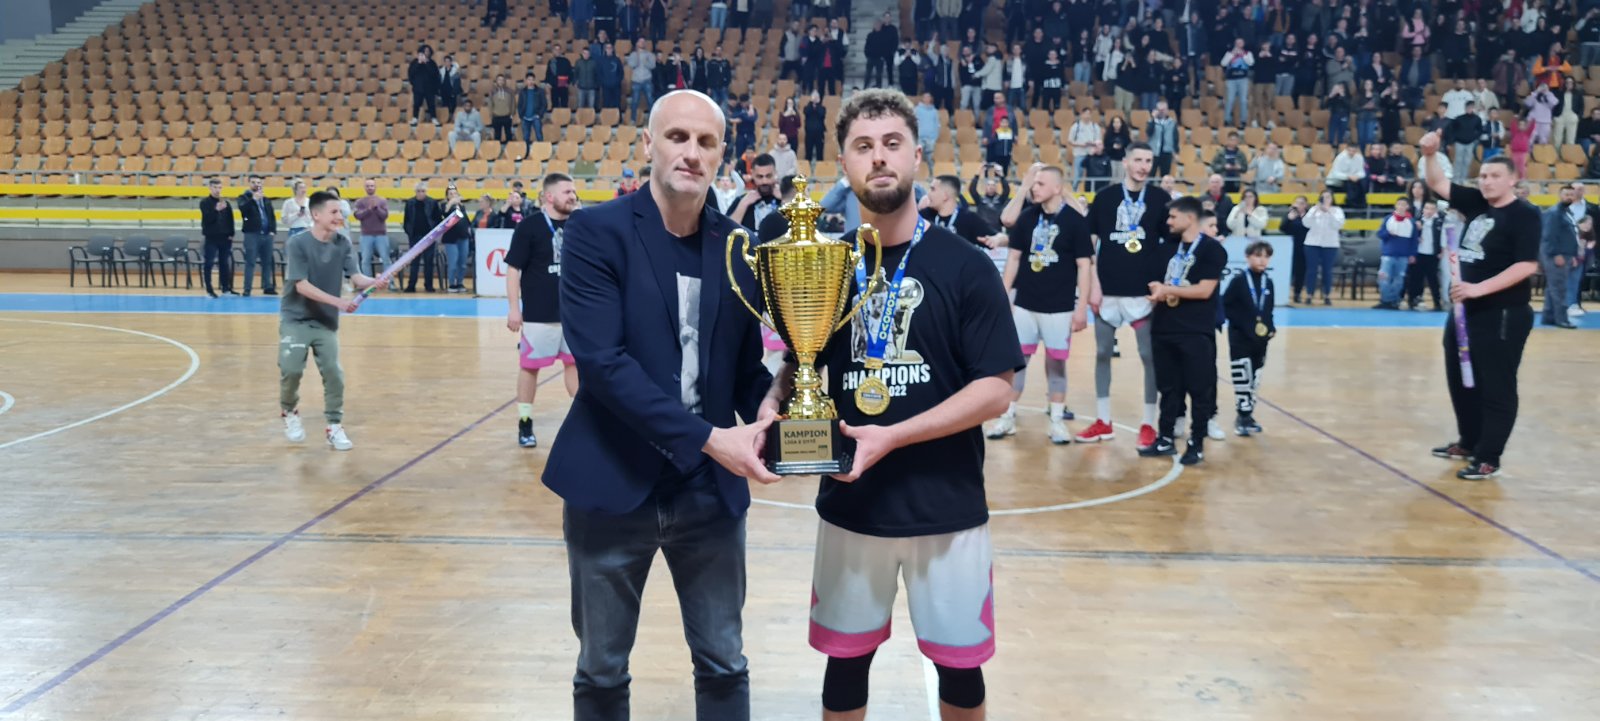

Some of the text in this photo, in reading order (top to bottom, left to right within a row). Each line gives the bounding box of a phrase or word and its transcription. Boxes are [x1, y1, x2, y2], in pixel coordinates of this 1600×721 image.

[880, 291, 896, 340] KOSOVO
[888, 384, 907, 397] 022
[784, 430, 828, 438] KAMPION
